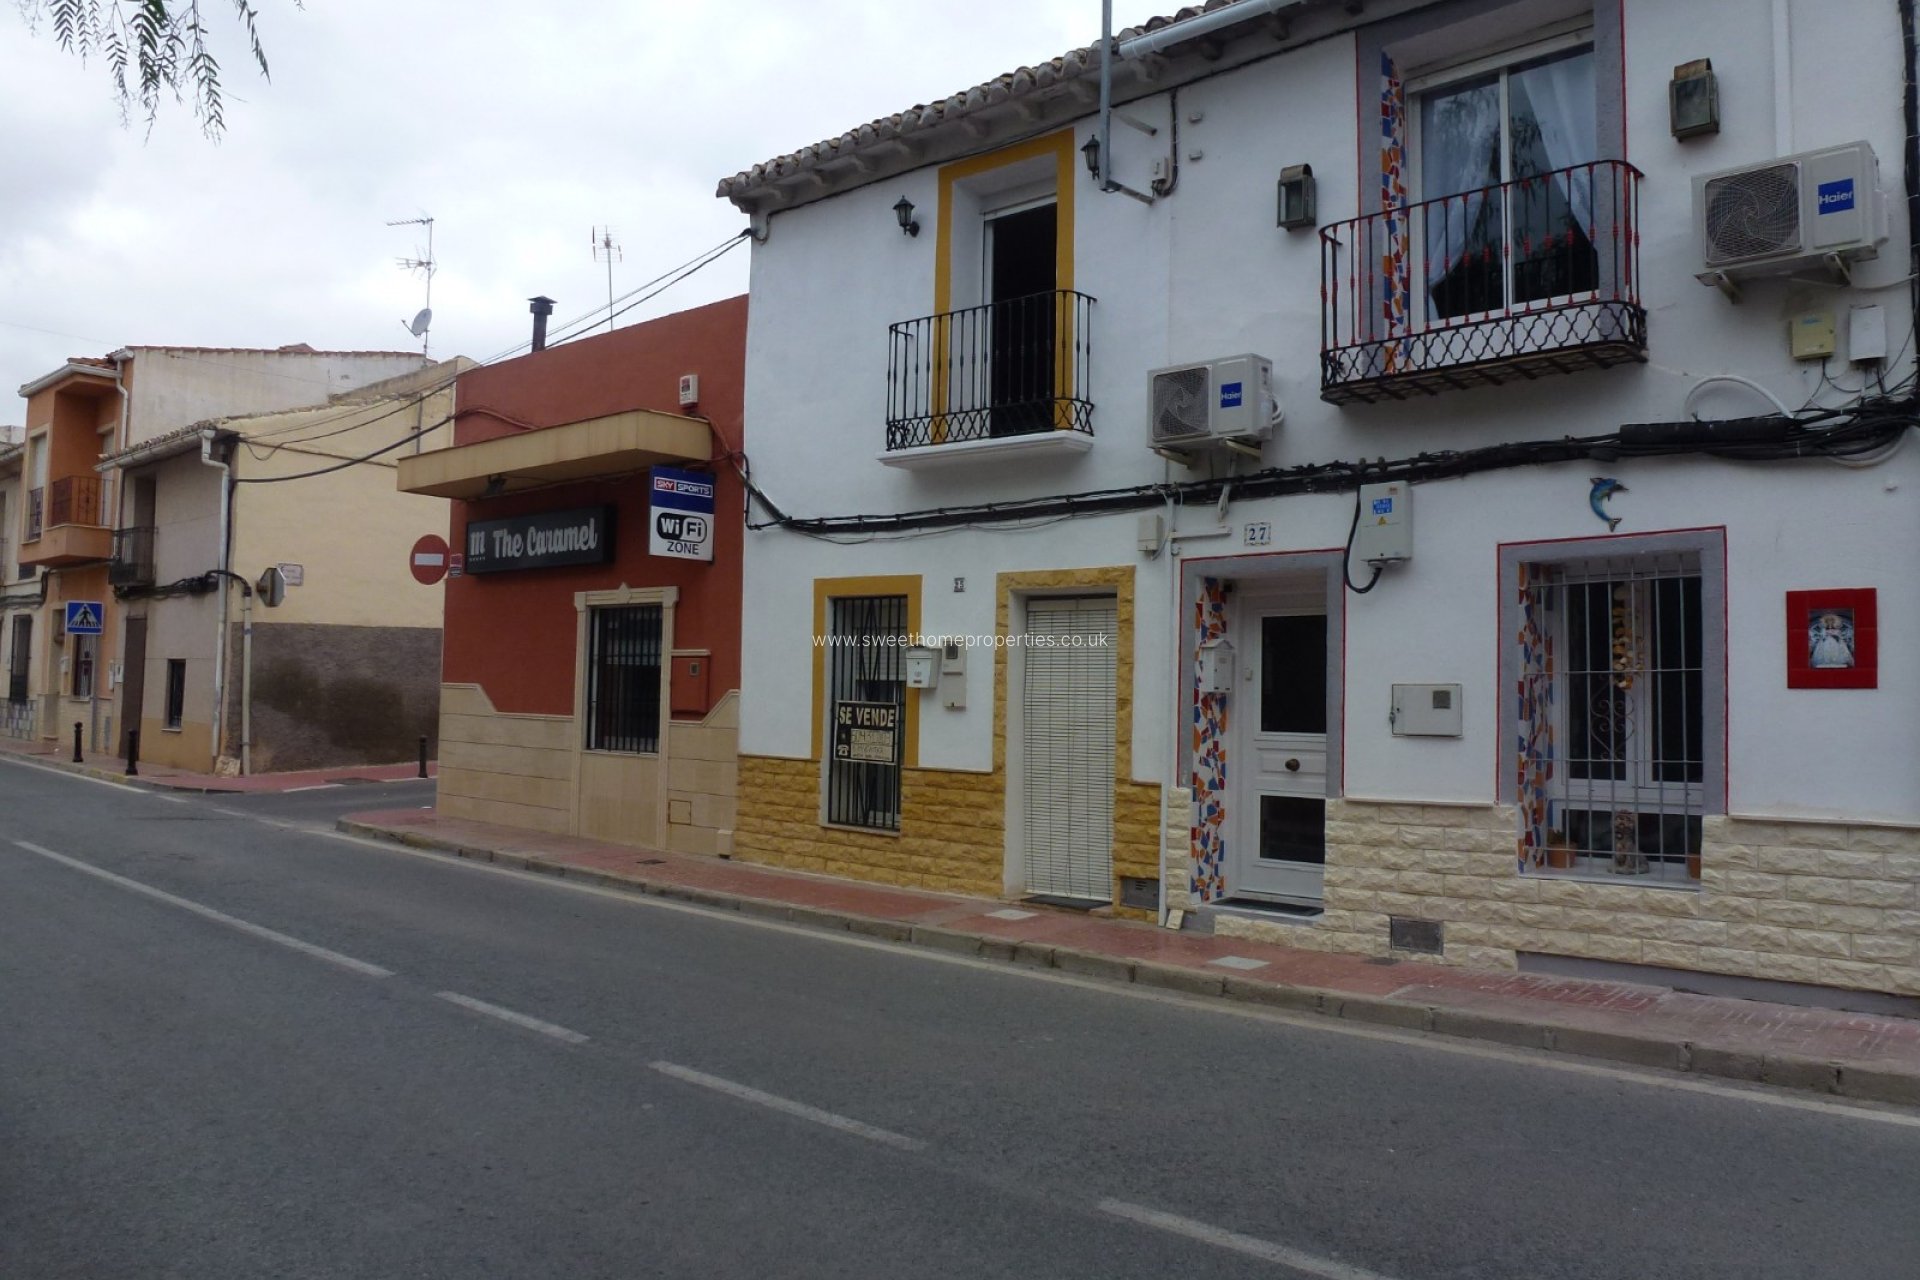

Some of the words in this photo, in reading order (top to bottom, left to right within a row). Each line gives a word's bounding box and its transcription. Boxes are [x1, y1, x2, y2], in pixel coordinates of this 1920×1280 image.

[1819, 191, 1852, 205] Haier
[1221, 391, 1241, 401] Haier
[656, 480, 674, 489] SKY
[677, 483, 710, 495] SPORTS
[493, 528, 524, 559] The
[526, 517, 598, 557] Caramel
[1248, 527, 1266, 541] 27
[667, 541, 699, 555] ZONE
[839, 706, 852, 725] SE
[856, 707, 895, 727] VENDE
